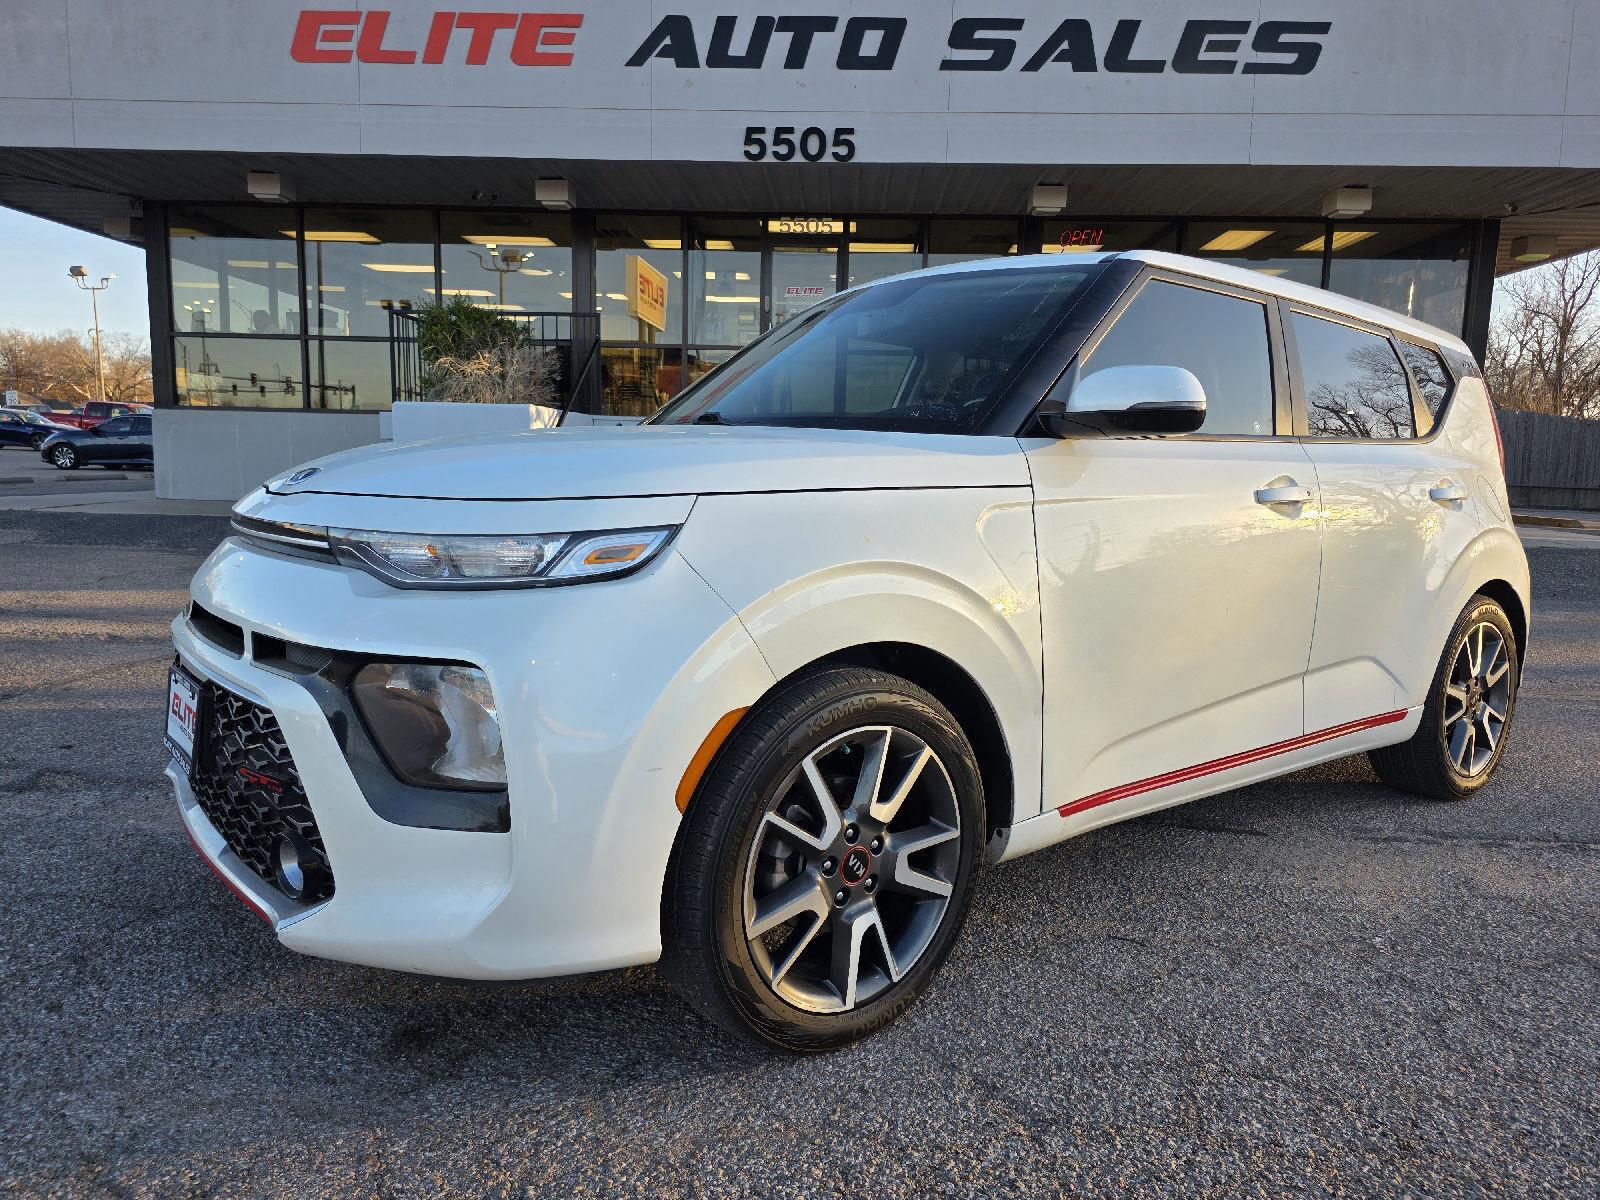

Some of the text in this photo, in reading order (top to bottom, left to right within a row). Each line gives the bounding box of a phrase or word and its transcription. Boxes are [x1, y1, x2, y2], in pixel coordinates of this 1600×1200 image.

[291, 10, 1332, 75] ELITE AUTO SALES
[743, 126, 856, 163] 5505
[780, 217, 833, 235] 5505
[1060, 229, 1103, 247] OPEN
[786, 287, 824, 295] ELITE
[171, 692, 198, 735] ELITE
[806, 697, 878, 737] KUMHO
[849, 853, 866, 877] KIA
